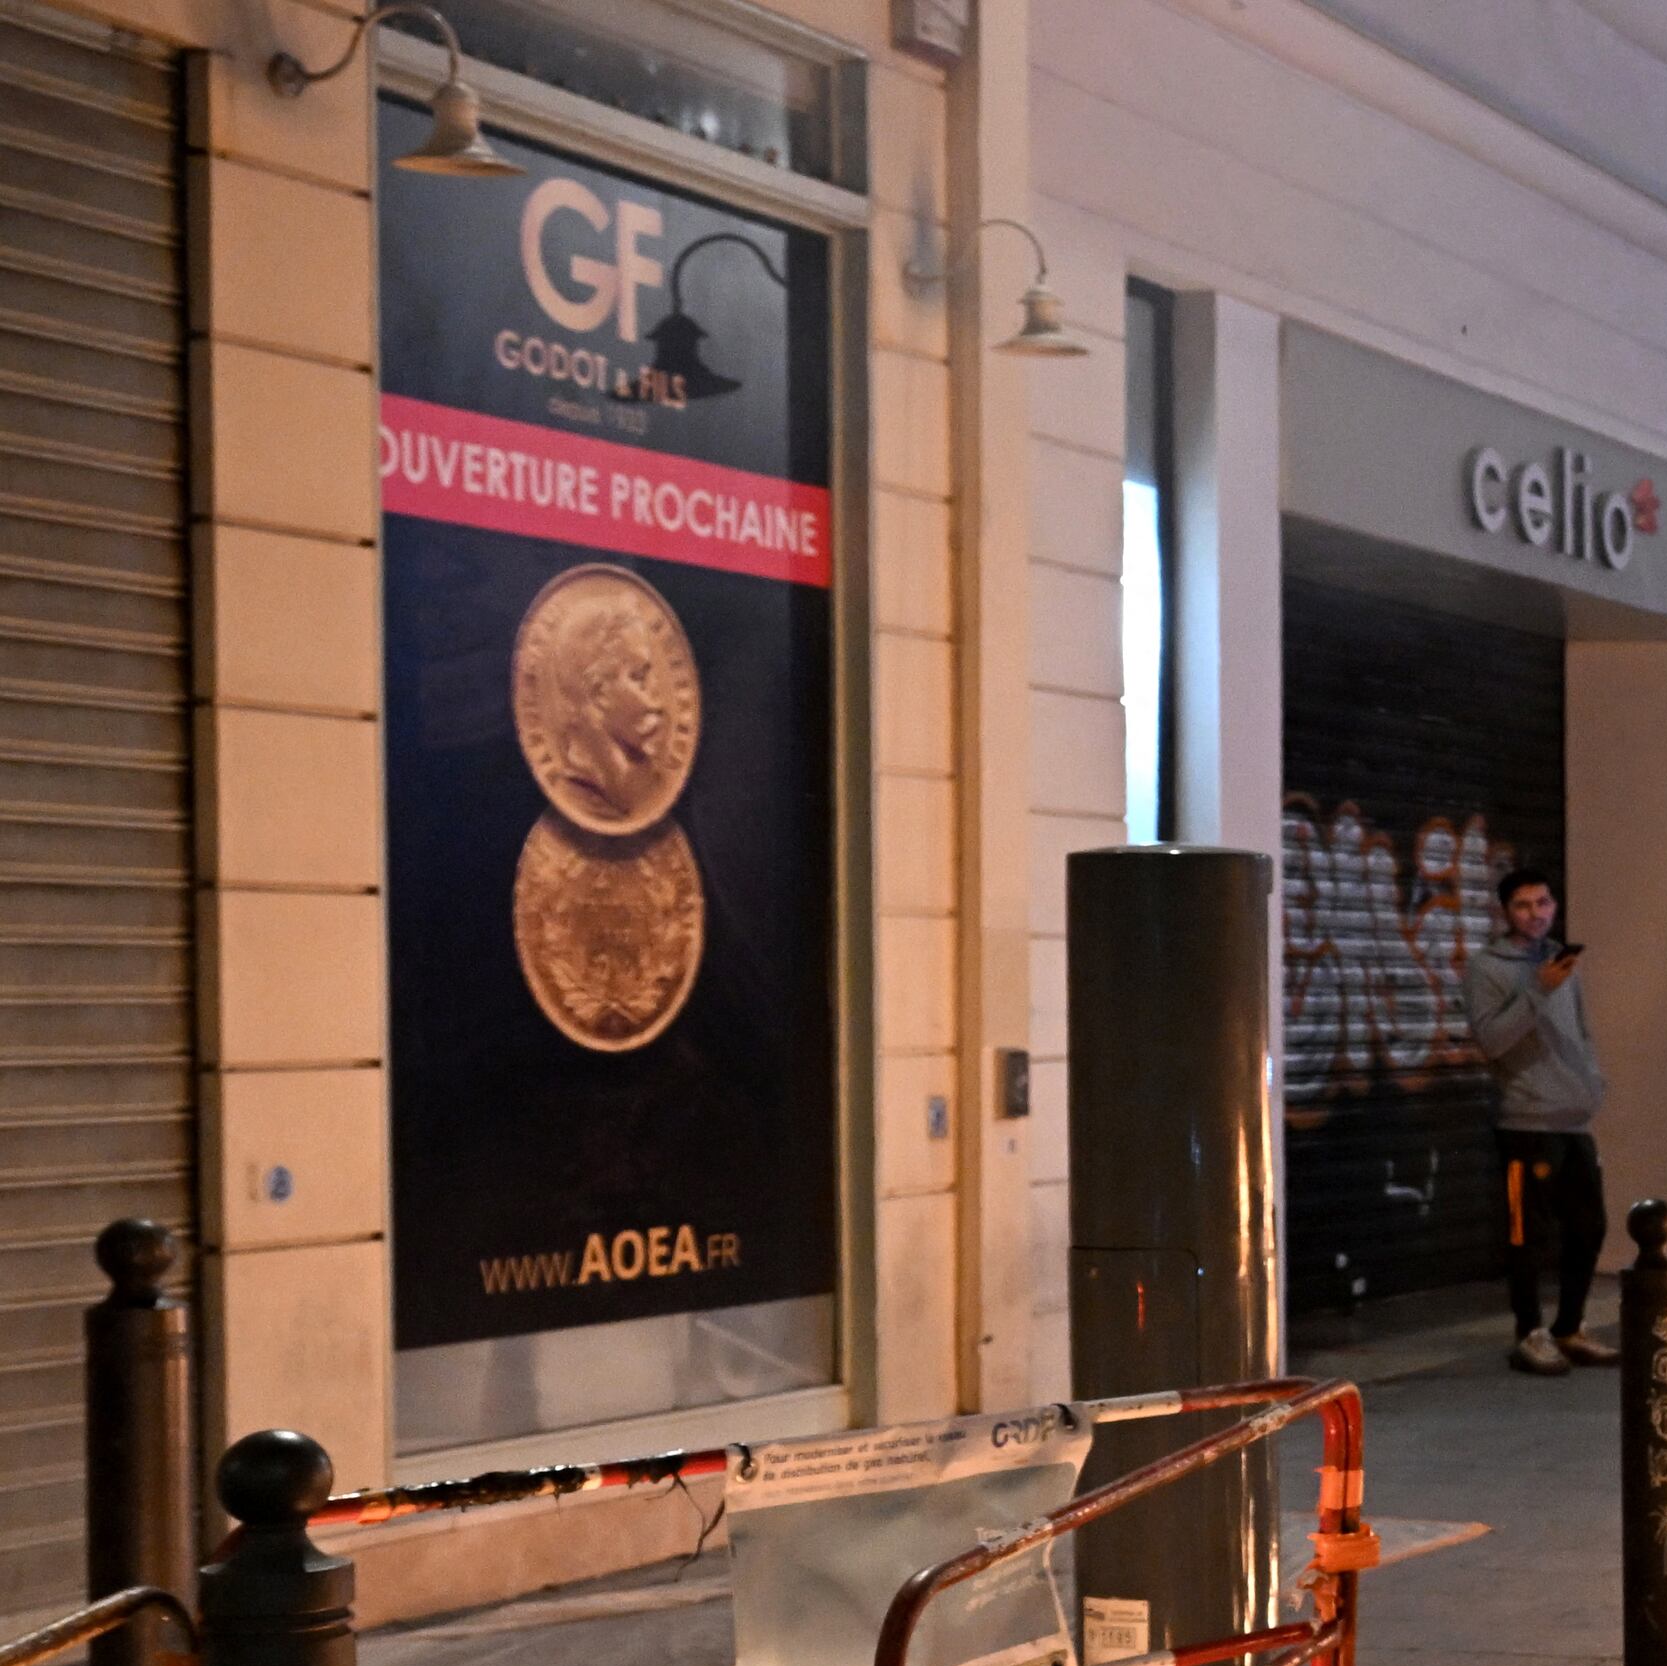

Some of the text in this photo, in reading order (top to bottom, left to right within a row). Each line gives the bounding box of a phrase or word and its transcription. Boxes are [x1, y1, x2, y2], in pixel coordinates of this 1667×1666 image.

[520, 177, 664, 344] GF
[494, 329, 689, 411] GODOT & FILS
[379, 424, 819, 558] OUVERTURE PROCHAINE
